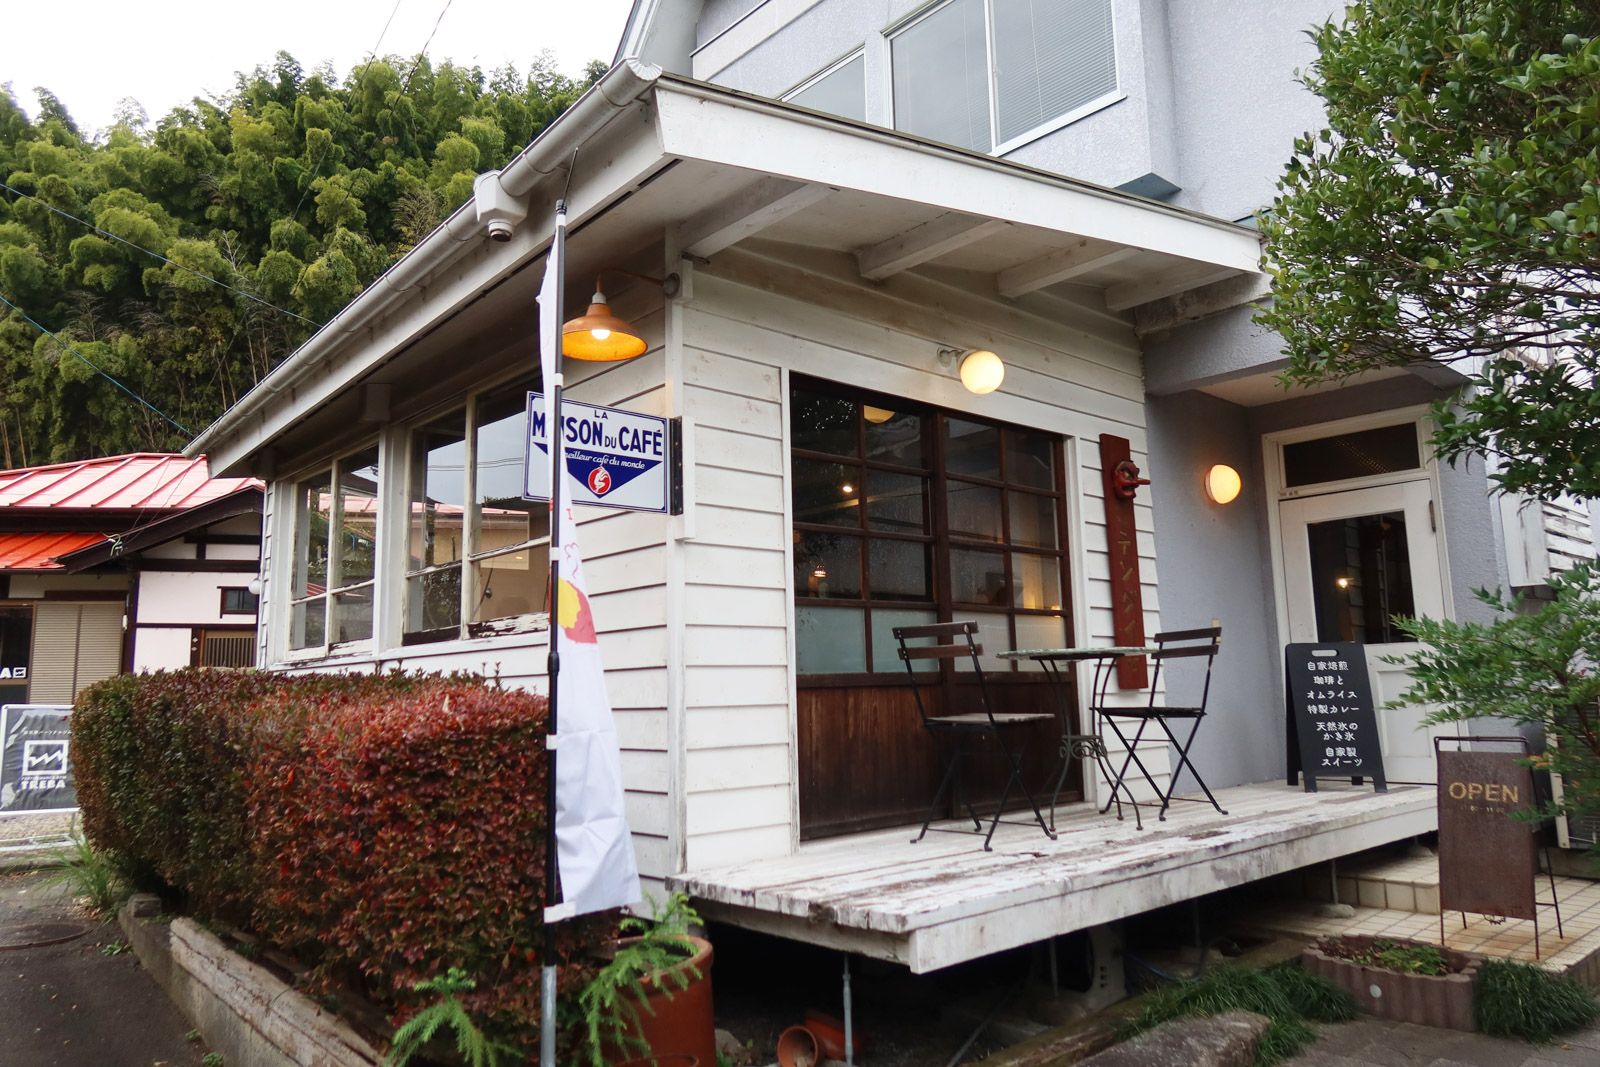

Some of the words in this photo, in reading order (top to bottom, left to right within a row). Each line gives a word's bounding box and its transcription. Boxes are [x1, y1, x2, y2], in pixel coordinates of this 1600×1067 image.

[594, 409, 609, 420] LA
[532, 411, 603, 447] MSON
[604, 435, 617, 449] DU
[618, 426, 663, 456] CAFÉ
[592, 454, 609, 466] café
[609, 457, 620, 466] du
[620, 460, 646, 470] monde
[1307, 661, 1349, 671] 自家焙煎
[1306, 690, 1358, 699] オムライス
[1306, 704, 1360, 714] 特製カレー
[1315, 721, 1358, 732] 天然氷の
[1323, 731, 1356, 742] かき氷
[1325, 746, 1358, 757] 自家製
[1321, 757, 1363, 767] スイーツ
[1449, 782, 1519, 803] OPEN
